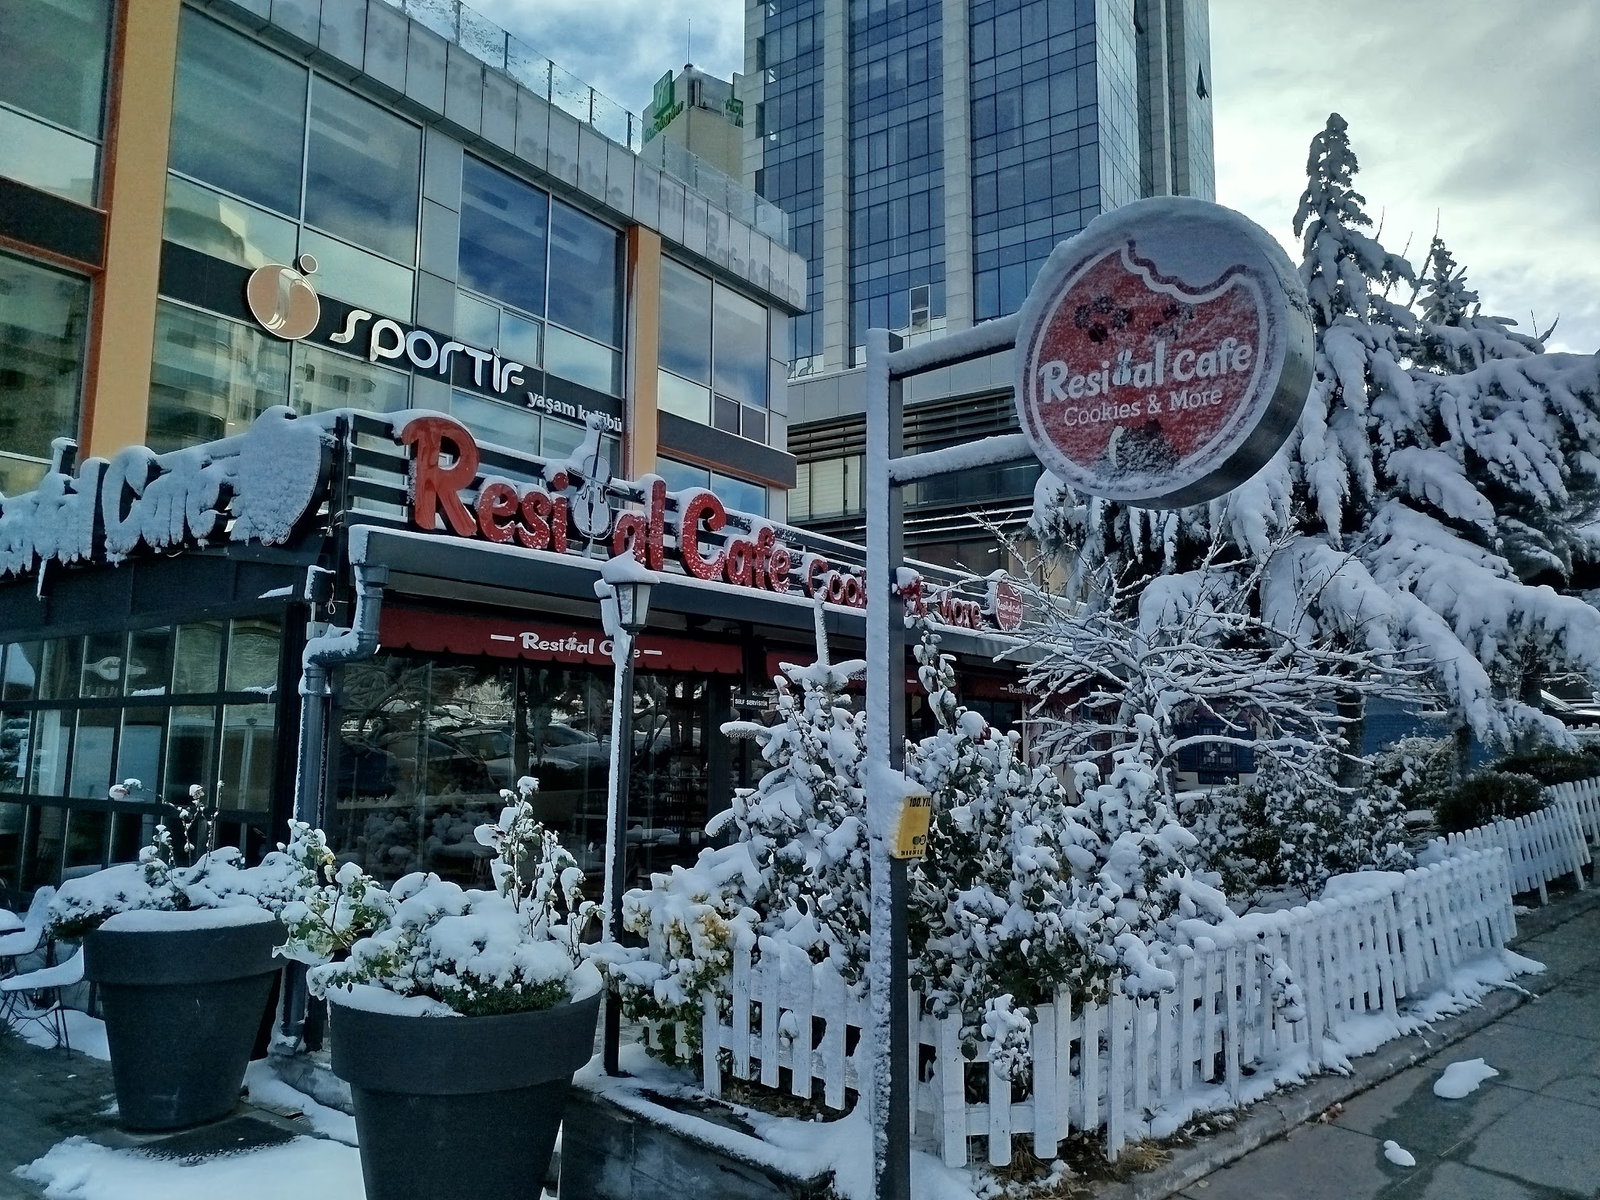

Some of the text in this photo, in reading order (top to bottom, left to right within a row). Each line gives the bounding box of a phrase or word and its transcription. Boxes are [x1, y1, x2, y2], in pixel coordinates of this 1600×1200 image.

[1173, 336, 1253, 382] Cafe
[526, 391, 622, 432] yaşam kübü
[1064, 388, 1223, 426] Cookies & More
[682, 492, 792, 594] Cafe
[599, 639, 641, 658] Ce
